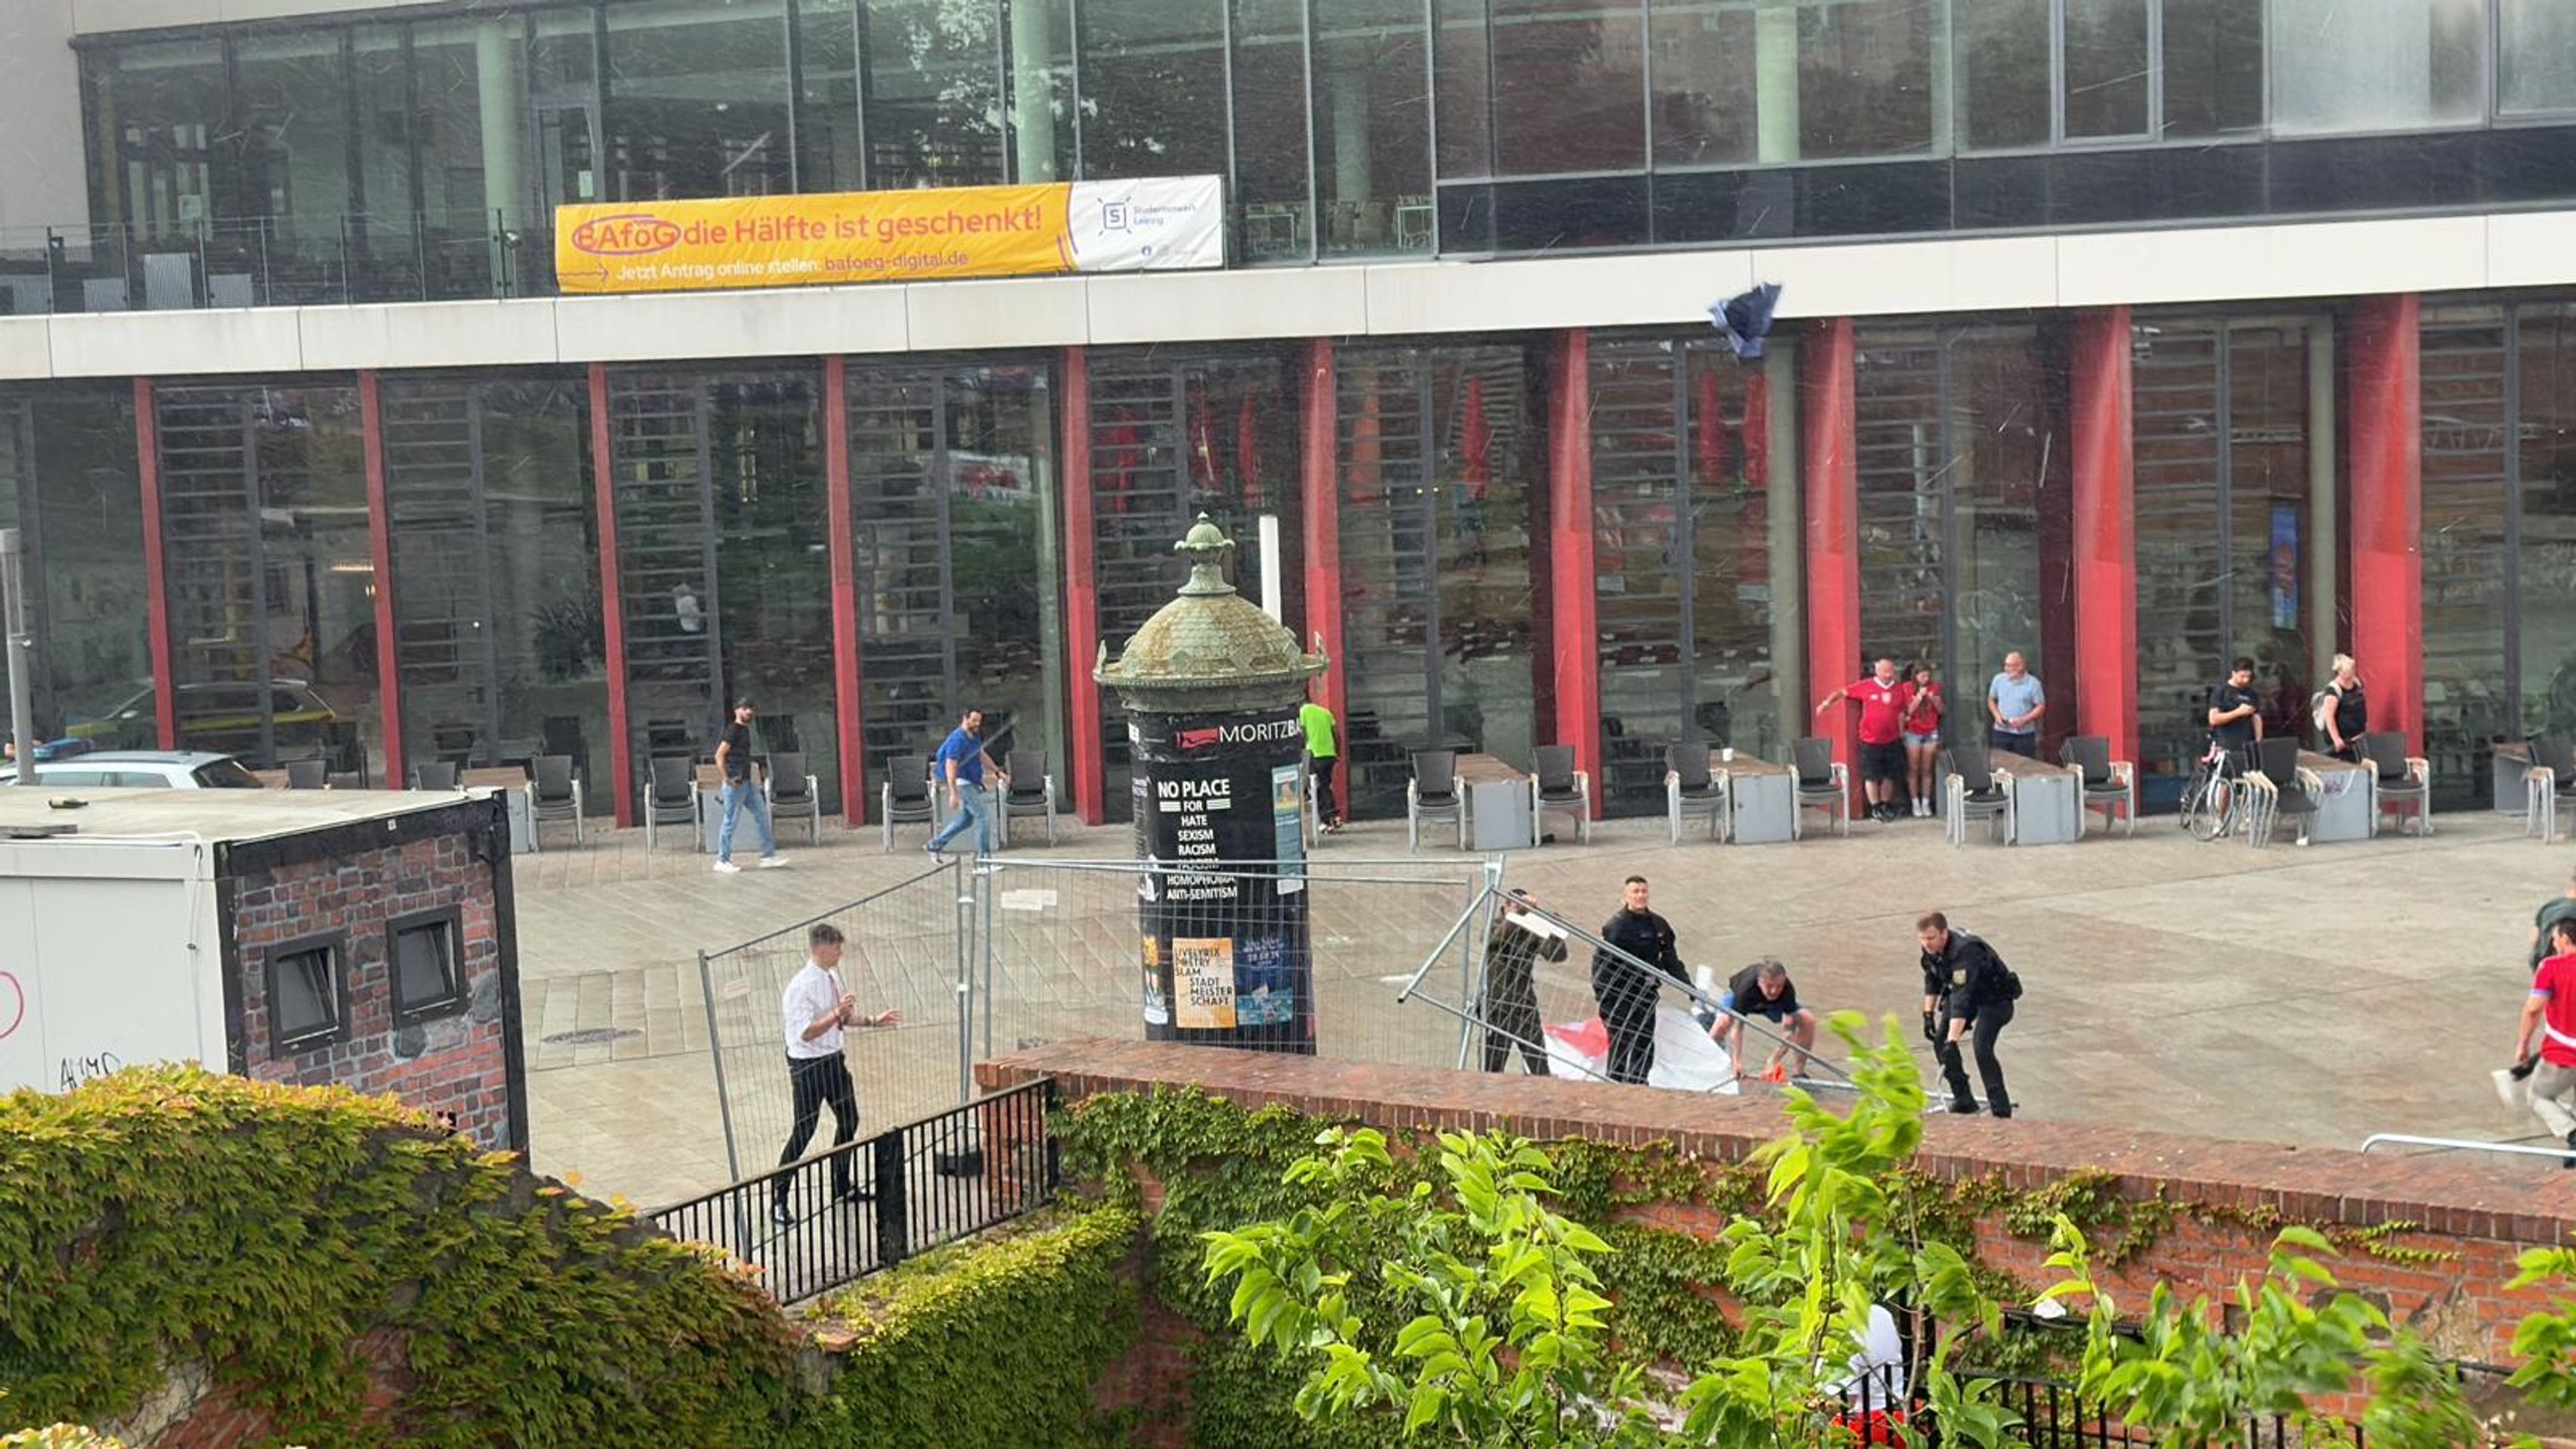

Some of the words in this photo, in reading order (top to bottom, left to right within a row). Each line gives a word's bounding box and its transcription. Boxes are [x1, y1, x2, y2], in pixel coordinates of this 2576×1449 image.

[684, 220, 728, 245] die
[734, 214, 826, 243] Hälfte
[835, 214, 869, 238] ist
[876, 205, 1042, 243] geschenkt!
[617, 263, 657, 281] Jetzt
[660, 261, 714, 279] Antrag
[718, 259, 762, 275] online
[1158, 781, 1180, 798] NO
[1182, 778, 1231, 797] PLACE
[1183, 800, 1203, 812] FOR
[1180, 815, 1208, 826] HATE
[1177, 829, 1214, 841] SEXISM
[1178, 843, 1217, 856] RACISM
[1190, 977, 1220, 986] STADT
[1190, 986, 1233, 996] MEISTER
